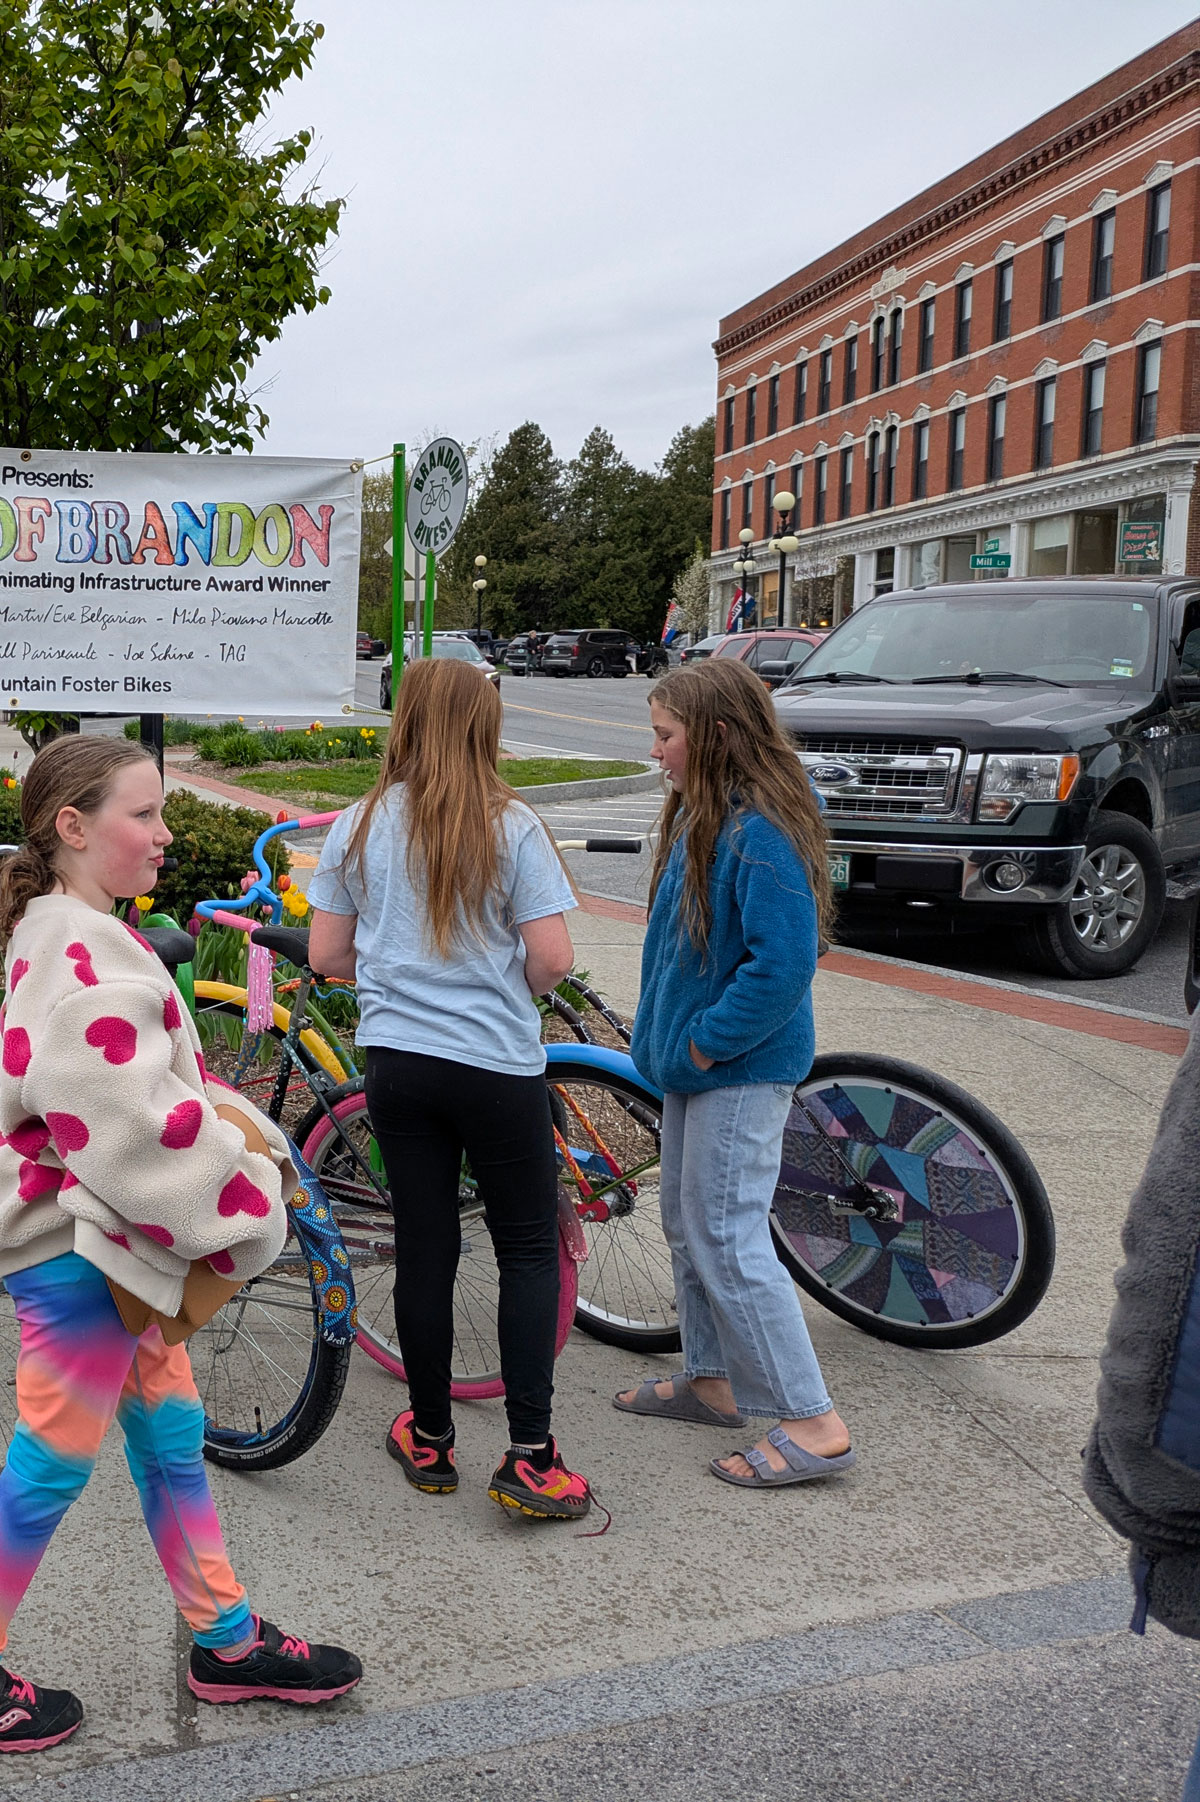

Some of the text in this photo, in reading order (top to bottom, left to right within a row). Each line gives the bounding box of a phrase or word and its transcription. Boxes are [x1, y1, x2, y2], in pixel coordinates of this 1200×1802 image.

[2, 466, 93, 488] Presents:
[413, 445, 463, 492] BRANDON
[54, 500, 335, 567] BRANDON
[413, 515, 453, 547] BIKES!
[976, 557, 993, 566] Mill
[80, 572, 201, 591] Infrastructure
[206, 576, 263, 592] Award
[268, 577, 331, 592] Winner
[273, 608, 333, 625] Marcotte
[124, 644, 144, 660] Joe
[220, 643, 245, 662] TAG
[62, 676, 118, 692] Foster
[124, 677, 171, 692] Bikes
